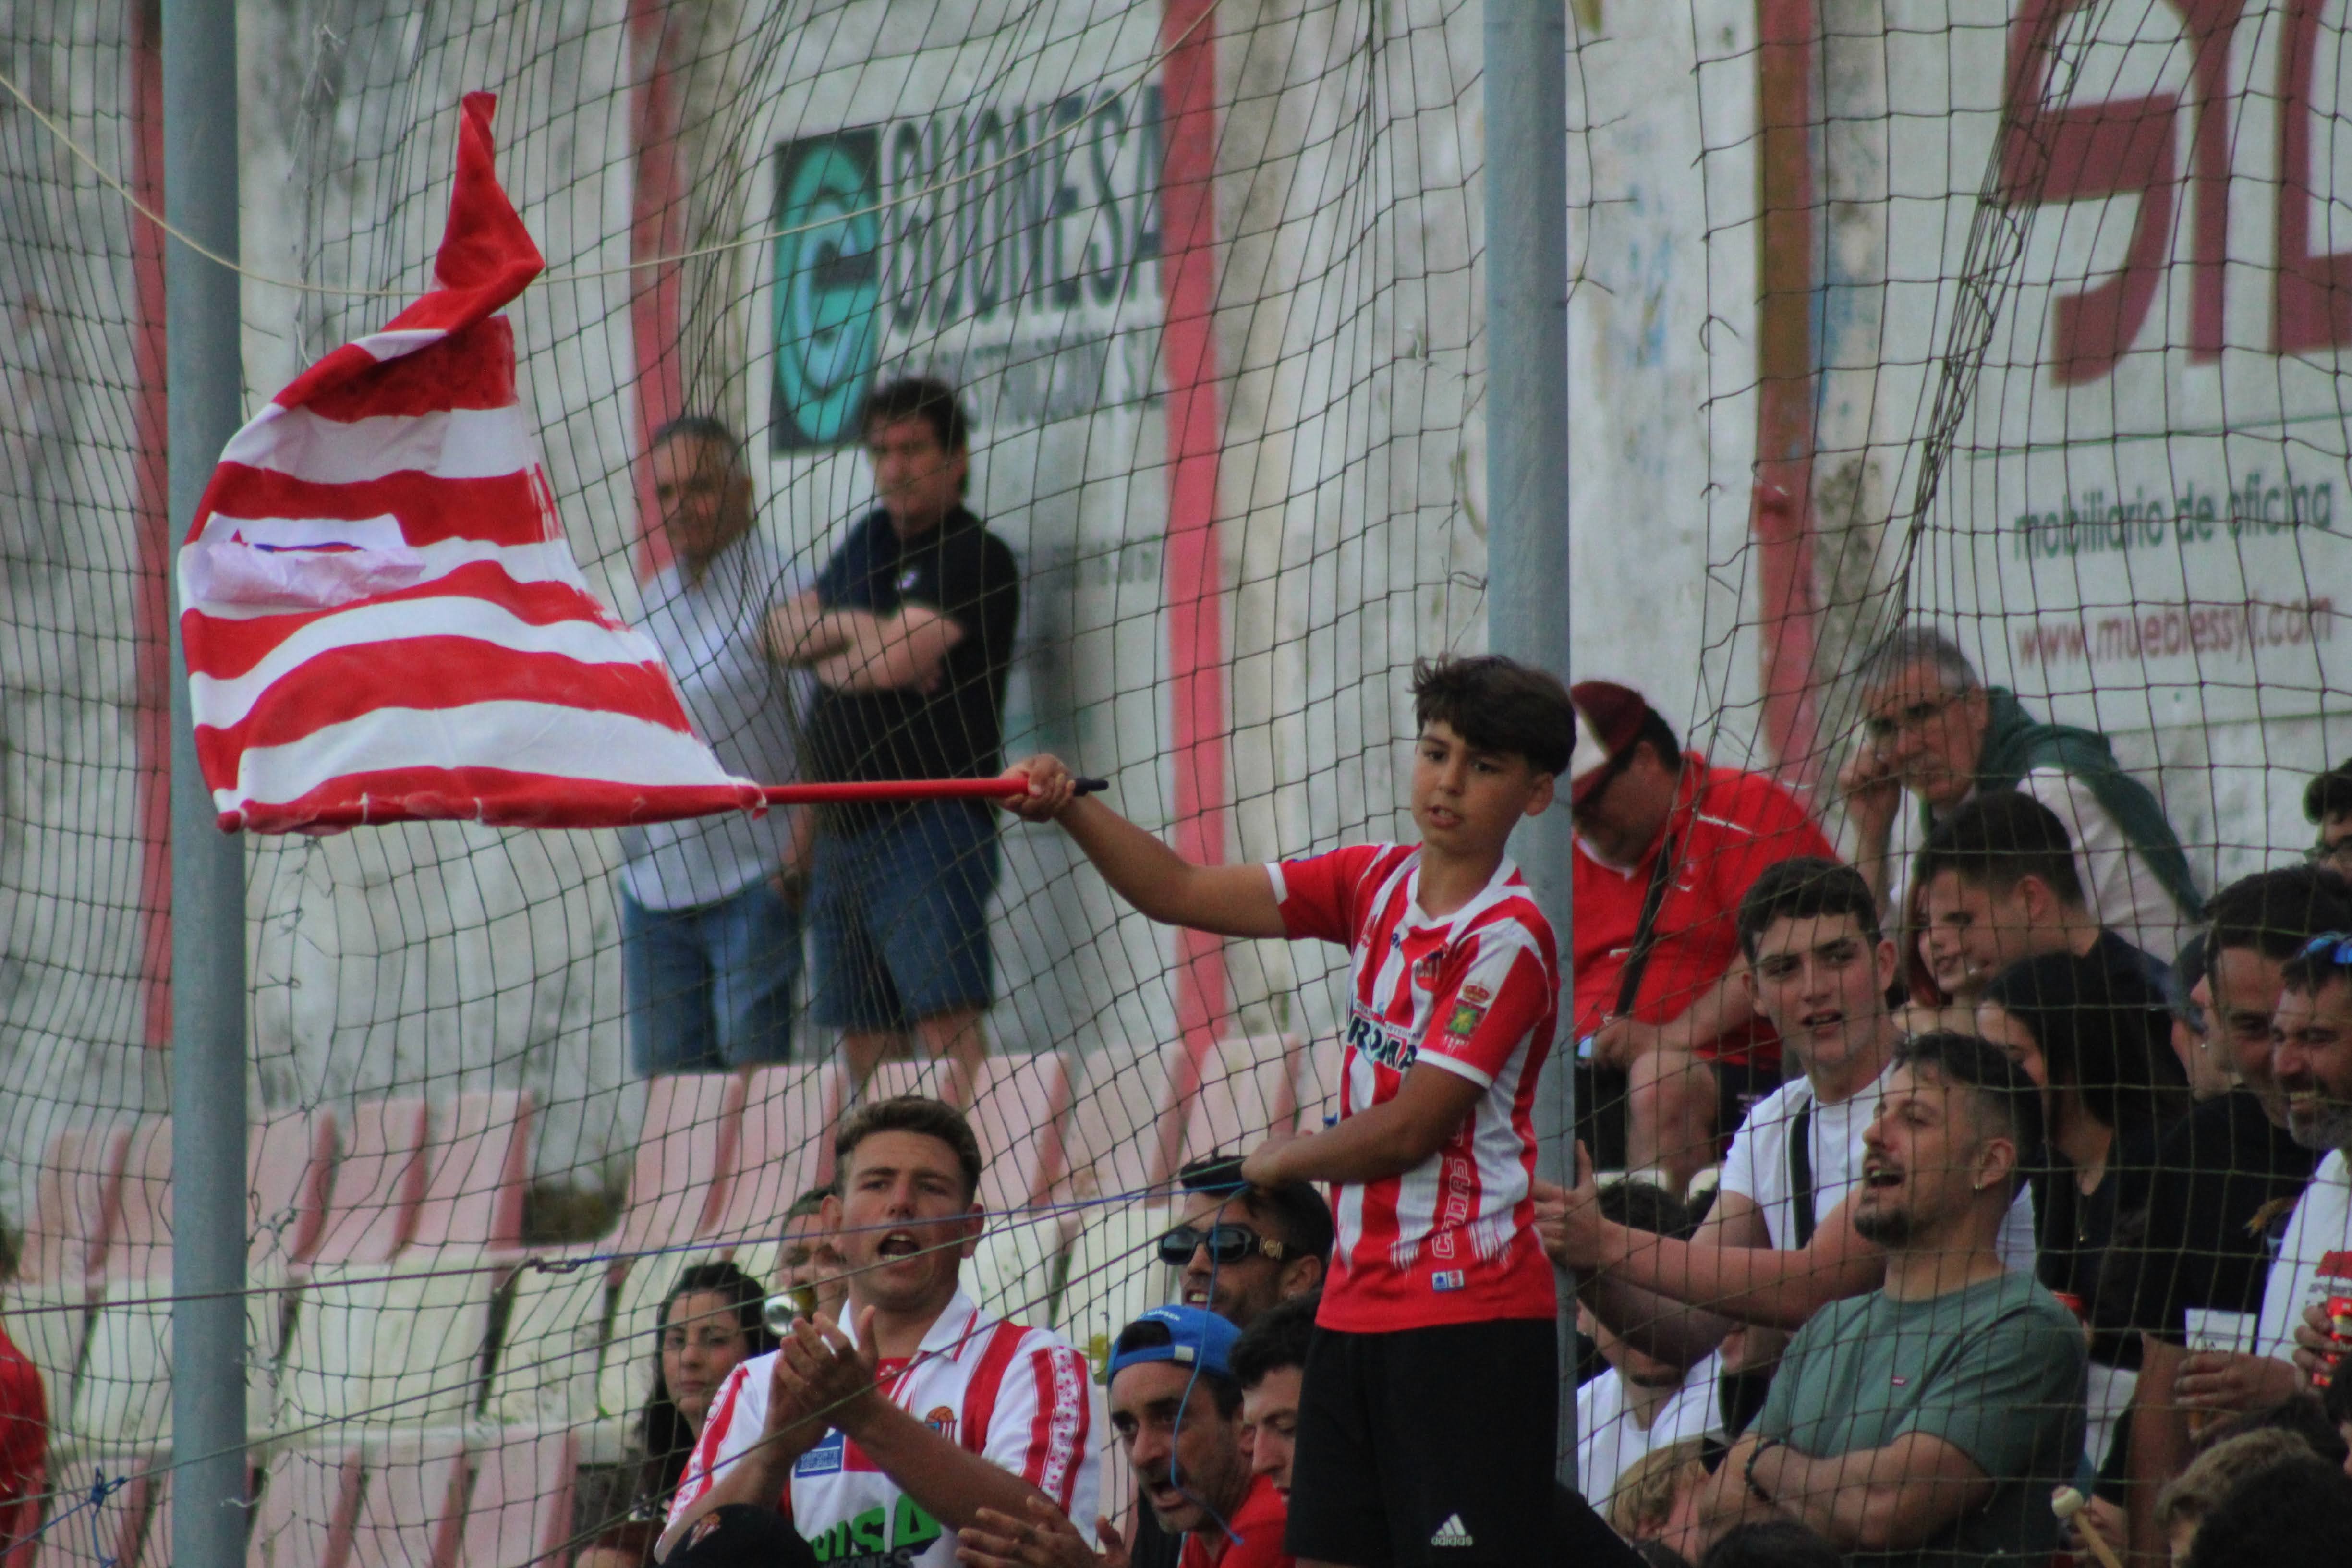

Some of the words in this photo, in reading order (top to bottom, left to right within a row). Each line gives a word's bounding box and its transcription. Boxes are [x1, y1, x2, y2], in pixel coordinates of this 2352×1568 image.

[2013, 484, 2165, 562] mobiliario
[2176, 479, 2215, 545] de
[2226, 469, 2333, 539] oficina
[1431, 1535, 1473, 1547] adidas
